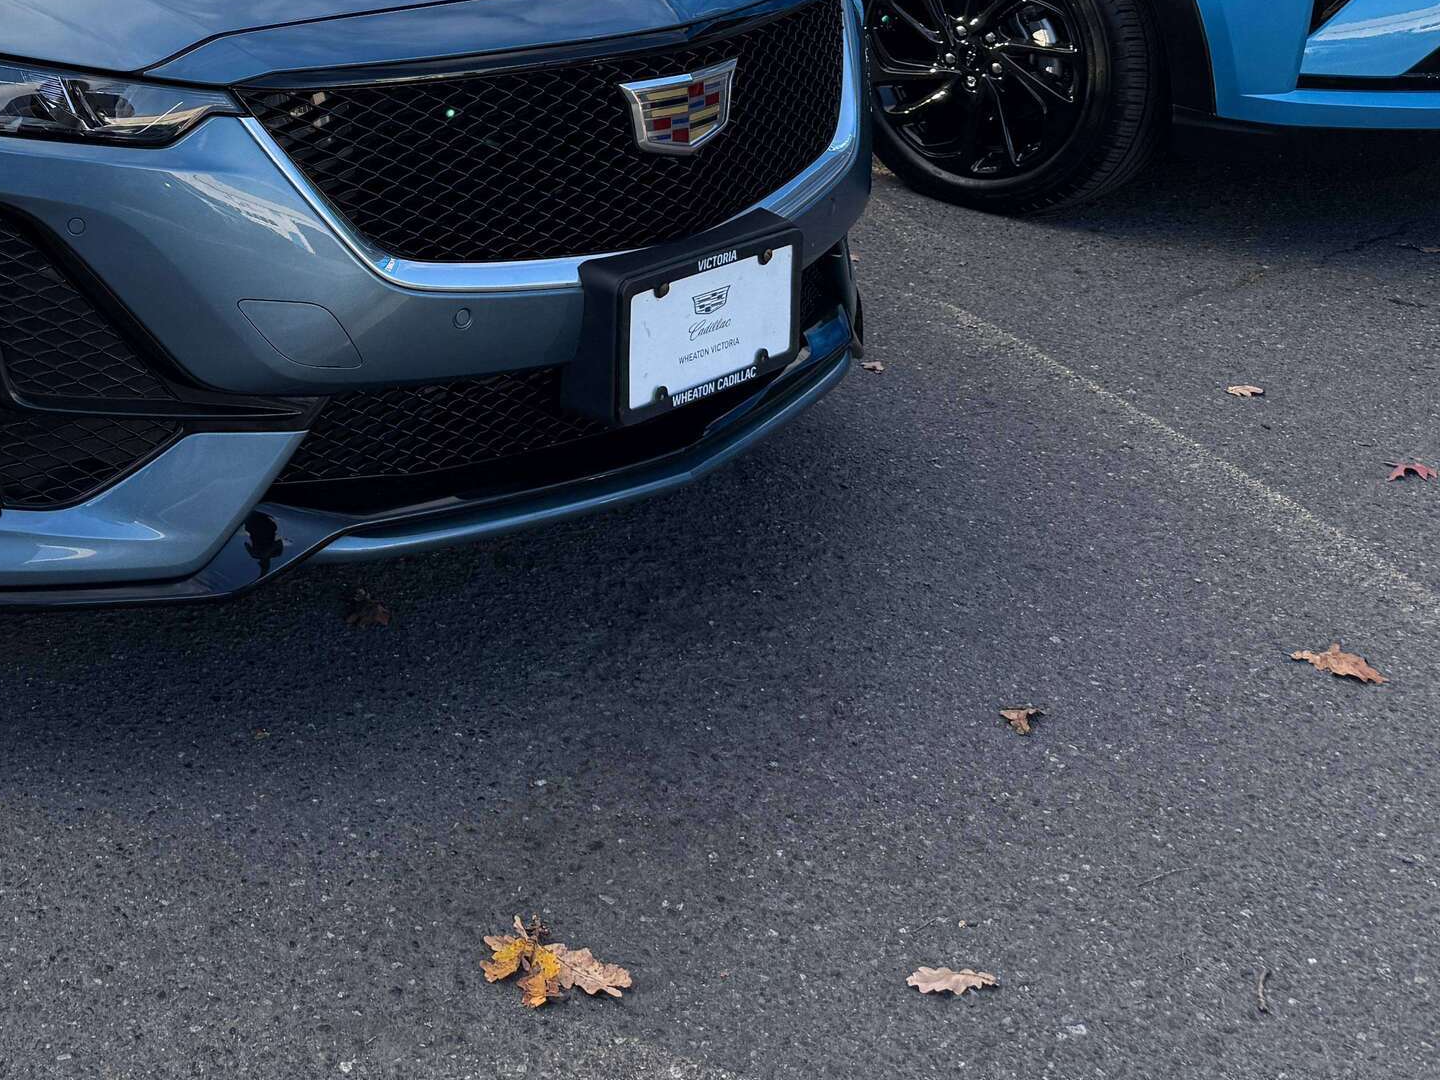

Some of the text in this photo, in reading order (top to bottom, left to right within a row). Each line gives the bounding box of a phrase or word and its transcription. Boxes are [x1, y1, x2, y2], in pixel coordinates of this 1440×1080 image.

[697, 249, 738, 272] VICTORIA
[688, 317, 732, 342] Cadillac
[678, 336, 741, 365] WHEATON VICTORIA
[671, 366, 758, 408] WHEATON CADILLAC
